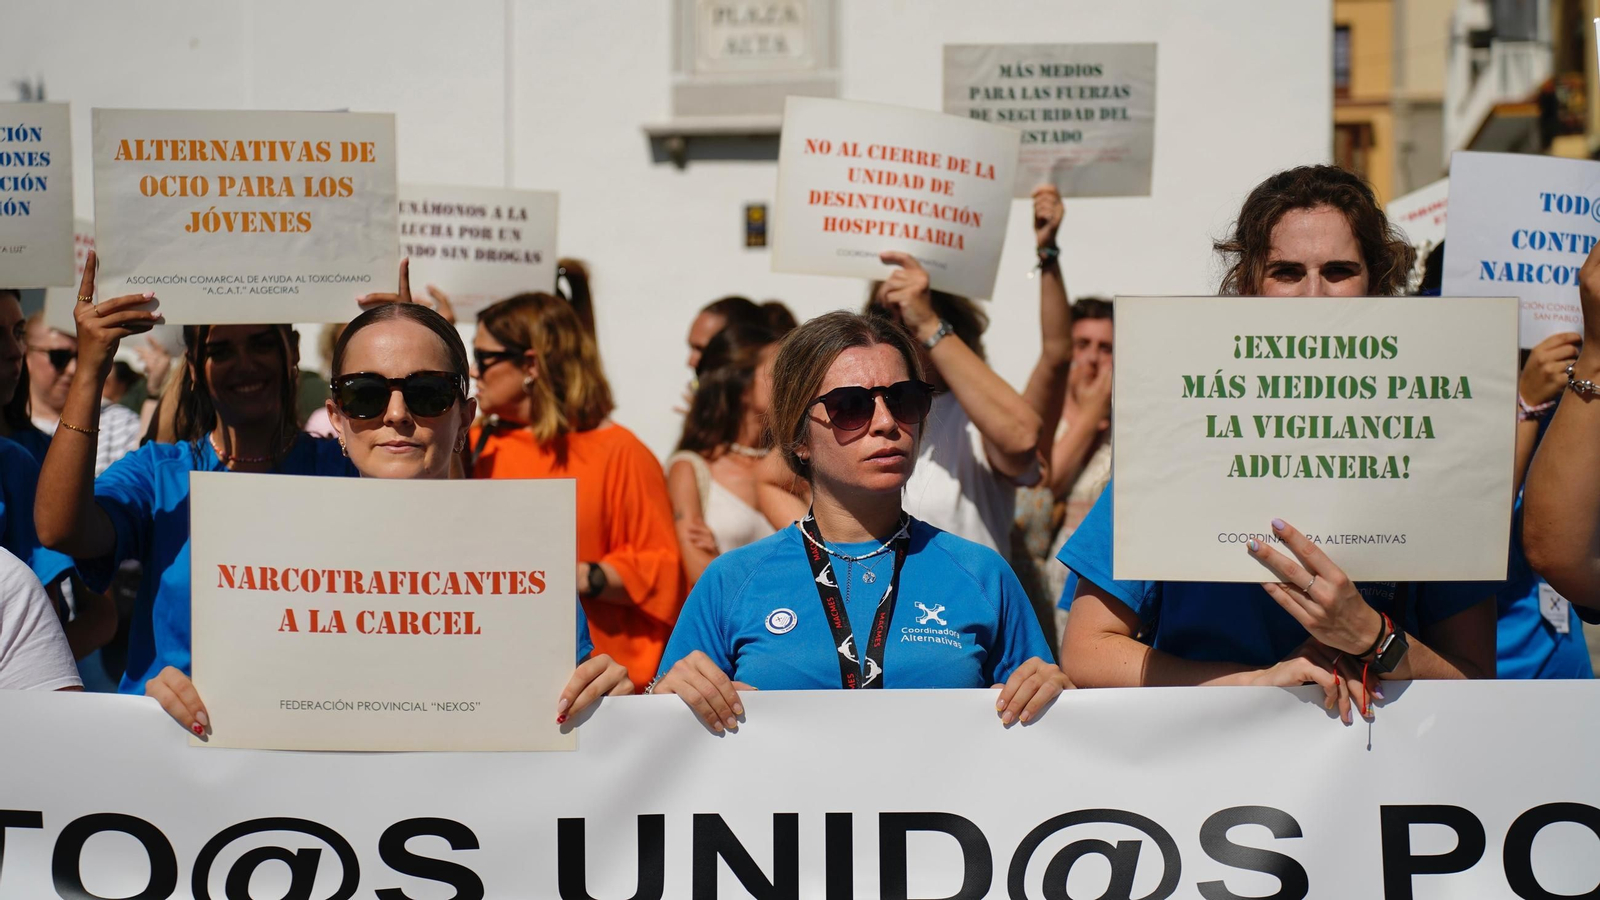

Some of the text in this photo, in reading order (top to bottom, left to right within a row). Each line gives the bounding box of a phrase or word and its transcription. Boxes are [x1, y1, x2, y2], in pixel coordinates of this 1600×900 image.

[998, 61, 1103, 78] MÁS MEDIOS
[969, 84, 1131, 101] PARA LAS FUERZAS
[969, 106, 1131, 122] DE SEGURIDAD DEL
[0, 123, 42, 143] IÓN
[114, 139, 376, 163] ALTERNATIVAS DE
[804, 138, 832, 155] NO
[836, 141, 862, 158] AL
[867, 144, 942, 168] CIERRE
[947, 155, 971, 174] DE
[975, 161, 996, 180] LA
[139, 175, 354, 198] OCIO PARA LOS
[847, 167, 955, 196] UNIDAD DE
[185, 206, 312, 233] JÓVENES
[808, 189, 983, 228] DESINTOXICACIÓN
[401, 222, 523, 242] LUCHA POR UN
[822, 216, 965, 251] HOSPITALARIA
[441, 246, 470, 259] SIN
[474, 249, 543, 264] DROGAS
[126, 273, 371, 284] ASOCIACIÓN COMARCAL DE AYUDA AL TOXICÓMANO
[249, 286, 300, 294] ALGECIRAS
[1233, 334, 1399, 360] ¡EXIGIMOS
[1182, 369, 1473, 400] MÁS MEDIOS PARA
[1205, 414, 1436, 440] LA VIGILANCIA
[1227, 454, 1411, 479] ADUANERA!
[1325, 533, 1407, 545] ALTERNATIVAS
[217, 564, 547, 595] NARCOTRAFICANTES
[278, 608, 482, 635] A LA CARCEL
[827, 596, 842, 629] MACMES
[873, 612, 887, 648] MACMES
[900, 634, 963, 650] Alternativas
[901, 626, 961, 639] Coordinadora
[279, 699, 354, 711] FEDERACIÓN
[357, 701, 428, 712] PROVINCIAL
[557, 804, 1310, 900] UNID@S
